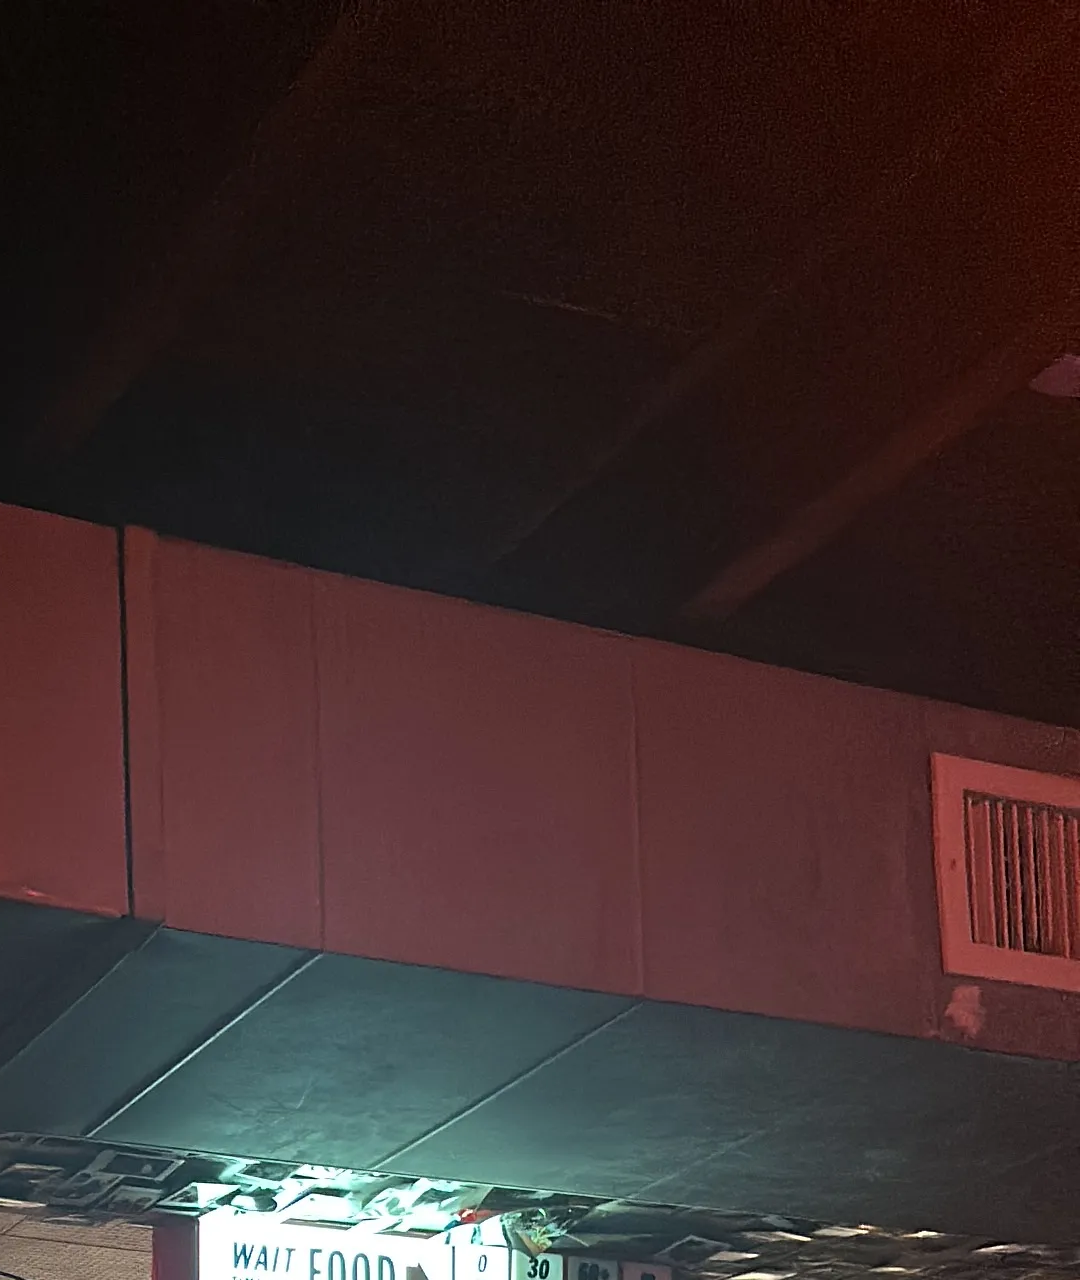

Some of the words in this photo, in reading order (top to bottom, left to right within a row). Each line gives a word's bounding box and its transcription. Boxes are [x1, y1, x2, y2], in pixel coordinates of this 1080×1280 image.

[233, 1242, 296, 1272] WAIT
[478, 1254, 487, 1272] 0
[527, 1257, 550, 1280] 30
